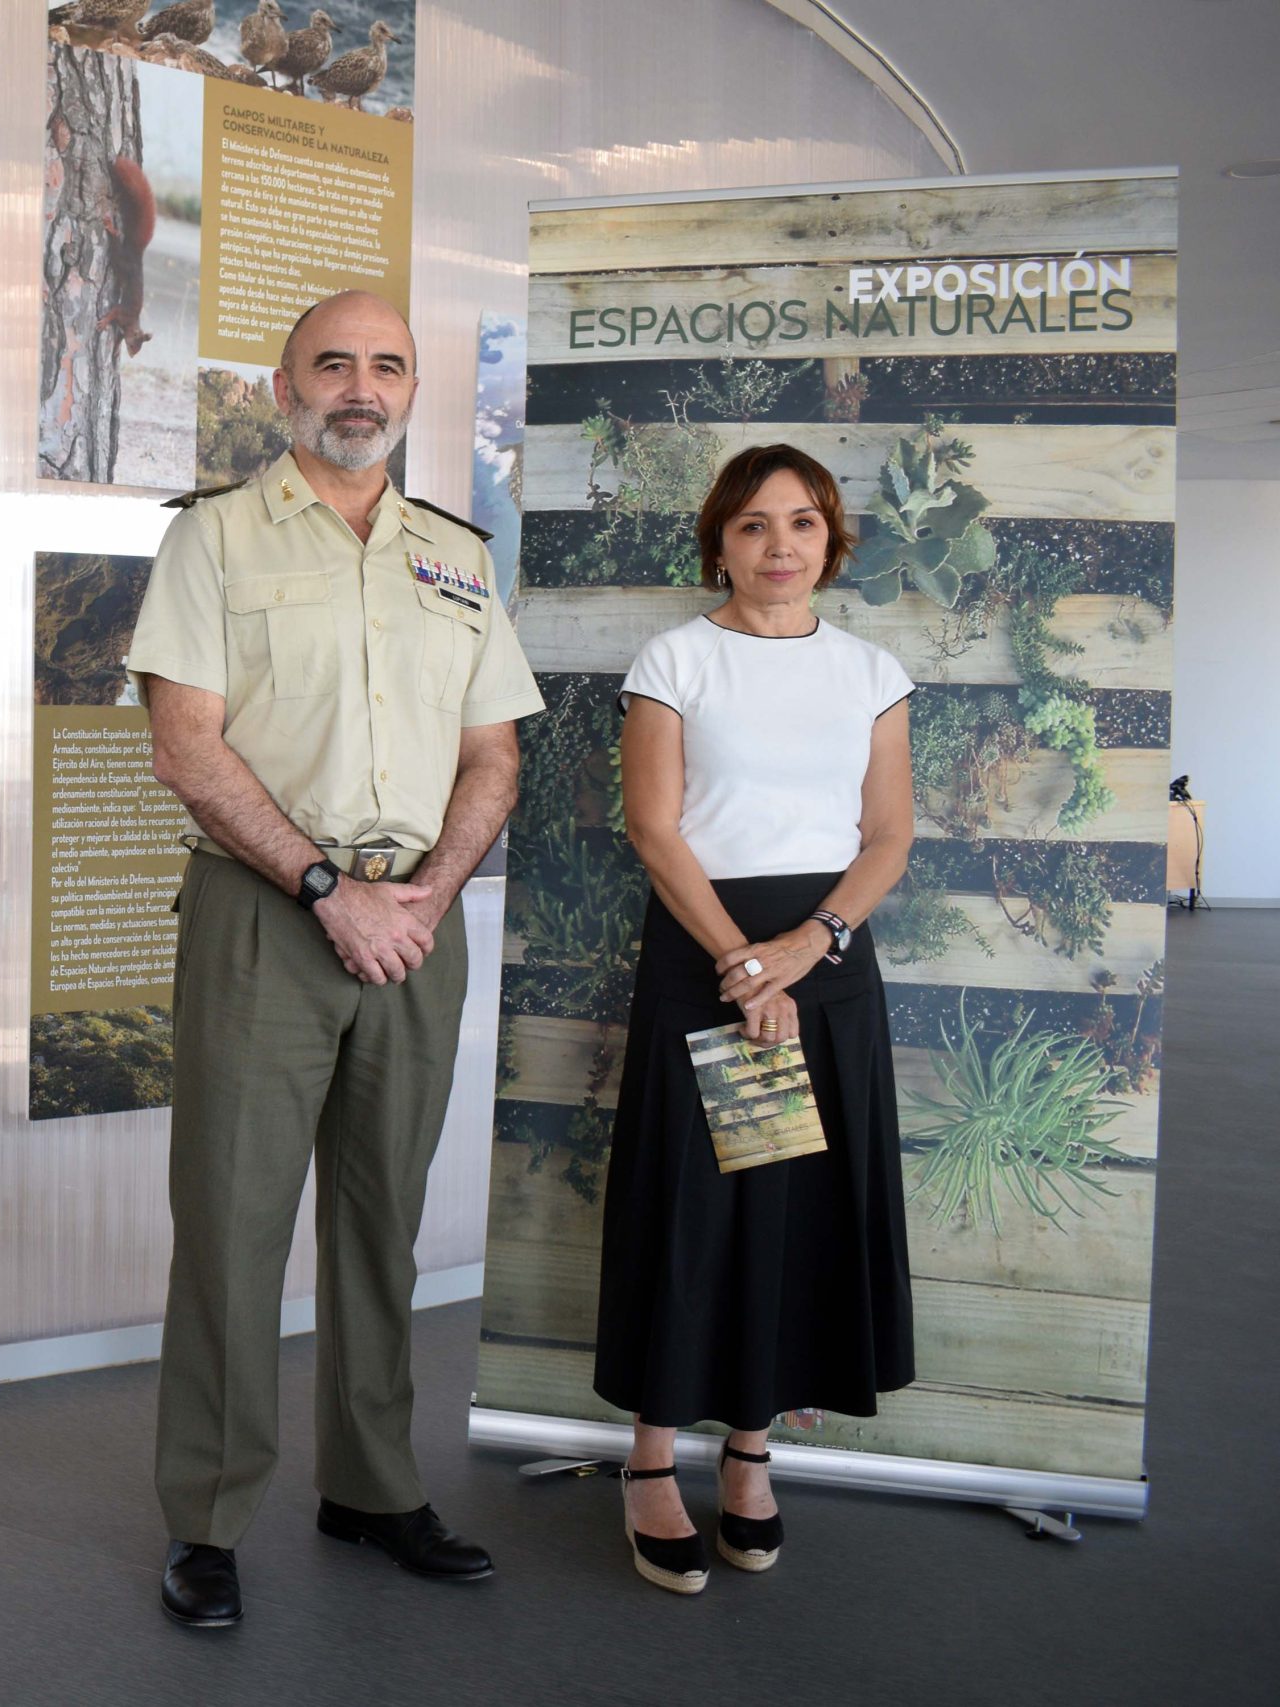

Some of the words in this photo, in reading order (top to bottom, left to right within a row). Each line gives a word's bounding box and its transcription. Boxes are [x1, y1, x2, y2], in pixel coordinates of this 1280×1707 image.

[223, 105, 265, 123] CAMPOS
[267, 115, 316, 135] MILITARES
[223, 119, 300, 145] CONSERVACIÓN
[302, 137, 315, 148] DE
[317, 140, 329, 151] LA
[331, 143, 390, 164] NATURALEZA
[849, 251, 1132, 304] EXPOSICIÓN
[569, 299, 808, 349] ESPACIOS
[826, 288, 1134, 339] NATURALES
[53, 729, 61, 739] La
[62, 729, 102, 739] Constitución
[103, 729, 131, 742] Española
[141, 729, 147, 739] el
[53, 743, 83, 755] Armadas,
[85, 743, 122, 753] constituidas
[123, 746, 134, 756] por
[136, 743, 142, 753] el
[53, 758, 78, 772] Ejército
[79, 758, 89, 769] del
[90, 758, 104, 770] Aire,
[107, 758, 127, 768] tienen
[53, 772, 98, 787] independencia
[99, 772, 108, 783] de
[108, 772, 132, 786] España,
[52, 787, 96, 799] ordenamiento
[97, 786, 141, 798] constitucional"
[158, 789, 166, 797] su
[52, 802, 101, 815] medioambiente,
[103, 801, 122, 812] indica
[122, 804, 135, 815] que:
[139, 801, 152, 812] "Los
[153, 800, 178, 815] poderes
[52, 817, 84, 828] utilización
[85, 816, 110, 827] racional
[111, 816, 119, 827] de
[120, 815, 137, 827] todos
[138, 815, 147, 826] los
[149, 818, 175, 826] recursos
[52, 831, 80, 846] proteger
[86, 830, 111, 845] mejorar
[113, 830, 119, 841] la
[119, 829, 141, 841] calidad
[142, 829, 151, 840] de
[152, 829, 157, 840] la
[159, 829, 171, 840] vida
[52, 847, 58, 858] el
[59, 846, 79, 858] medio
[80, 845, 109, 858] ambiente,
[111, 844, 147, 859] apoyándose
[148, 847, 156, 855] en
[157, 844, 163, 855] la
[51, 861, 81, 873] colectiva"
[51, 876, 62, 887] Por
[64, 875, 76, 887] ello
[77, 875, 87, 886] del
[88, 874, 120, 886] Ministerio
[120, 874, 129, 885] de
[129, 873, 155, 886] Defensa,
[157, 872, 183, 883] aunando
[51, 894, 59, 902] su
[60, 890, 84, 905] política
[85, 888, 133, 901] medioambiental
[134, 891, 142, 899] en
[143, 888, 149, 899] el
[150, 886, 177, 901] principio
[51, 905, 85, 920] compatible
[86, 907, 98, 915] con
[99, 904, 105, 915] la
[106, 903, 126, 915] misión
[127, 903, 135, 914] de
[136, 902, 145, 913] las
[146, 901, 170, 913] Fuerzas
[51, 920, 62, 932] Las
[63, 923, 88, 933] normas,
[90, 918, 116, 930] medidas
[122, 916, 158, 929] actuaciones
[51, 938, 60, 946] un
[61, 934, 73, 946] alto
[73, 933, 93, 949] grado
[93, 933, 102, 944] de
[103, 931, 143, 944] conservación
[143, 931, 152, 942] de
[153, 930, 161, 941] los
[51, 950, 60, 962] los
[61, 949, 70, 961] ha
[70, 948, 90, 960] hecho
[90, 946, 130, 959] merecedores
[131, 946, 139, 957] de
[141, 949, 151, 957] ser
[50, 964, 59, 976] de
[60, 963, 88, 979] Espacios
[88, 961, 119, 974] Naturales
[120, 959, 153, 975] protegidos
[154, 959, 162, 970] de
[50, 978, 77, 994] Europea
[78, 978, 86, 989] de
[87, 976, 114, 992] Espacios
[115, 974, 149, 990] Protegidos,
